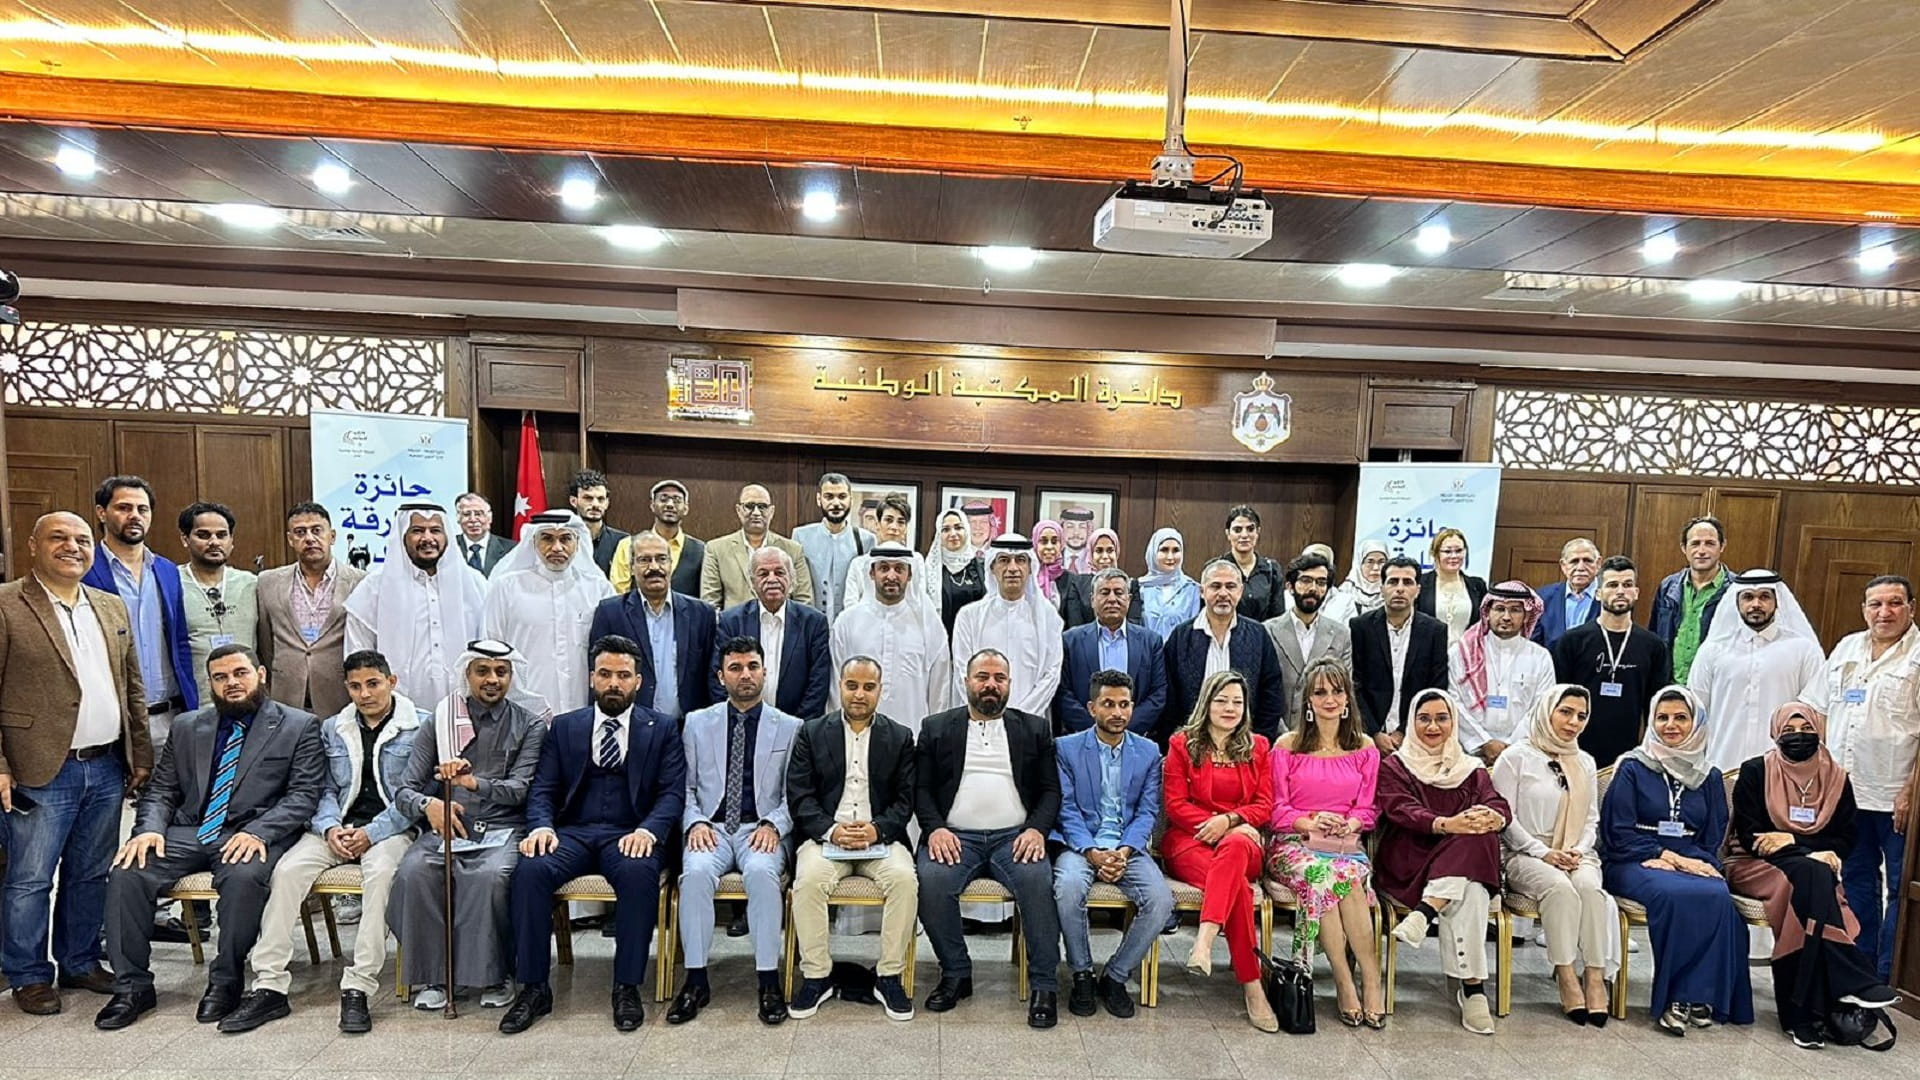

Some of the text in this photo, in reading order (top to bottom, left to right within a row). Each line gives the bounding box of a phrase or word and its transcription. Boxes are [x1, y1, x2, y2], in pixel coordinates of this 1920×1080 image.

[813, 364, 1183, 410] دائرة المكتبة الوطنية
